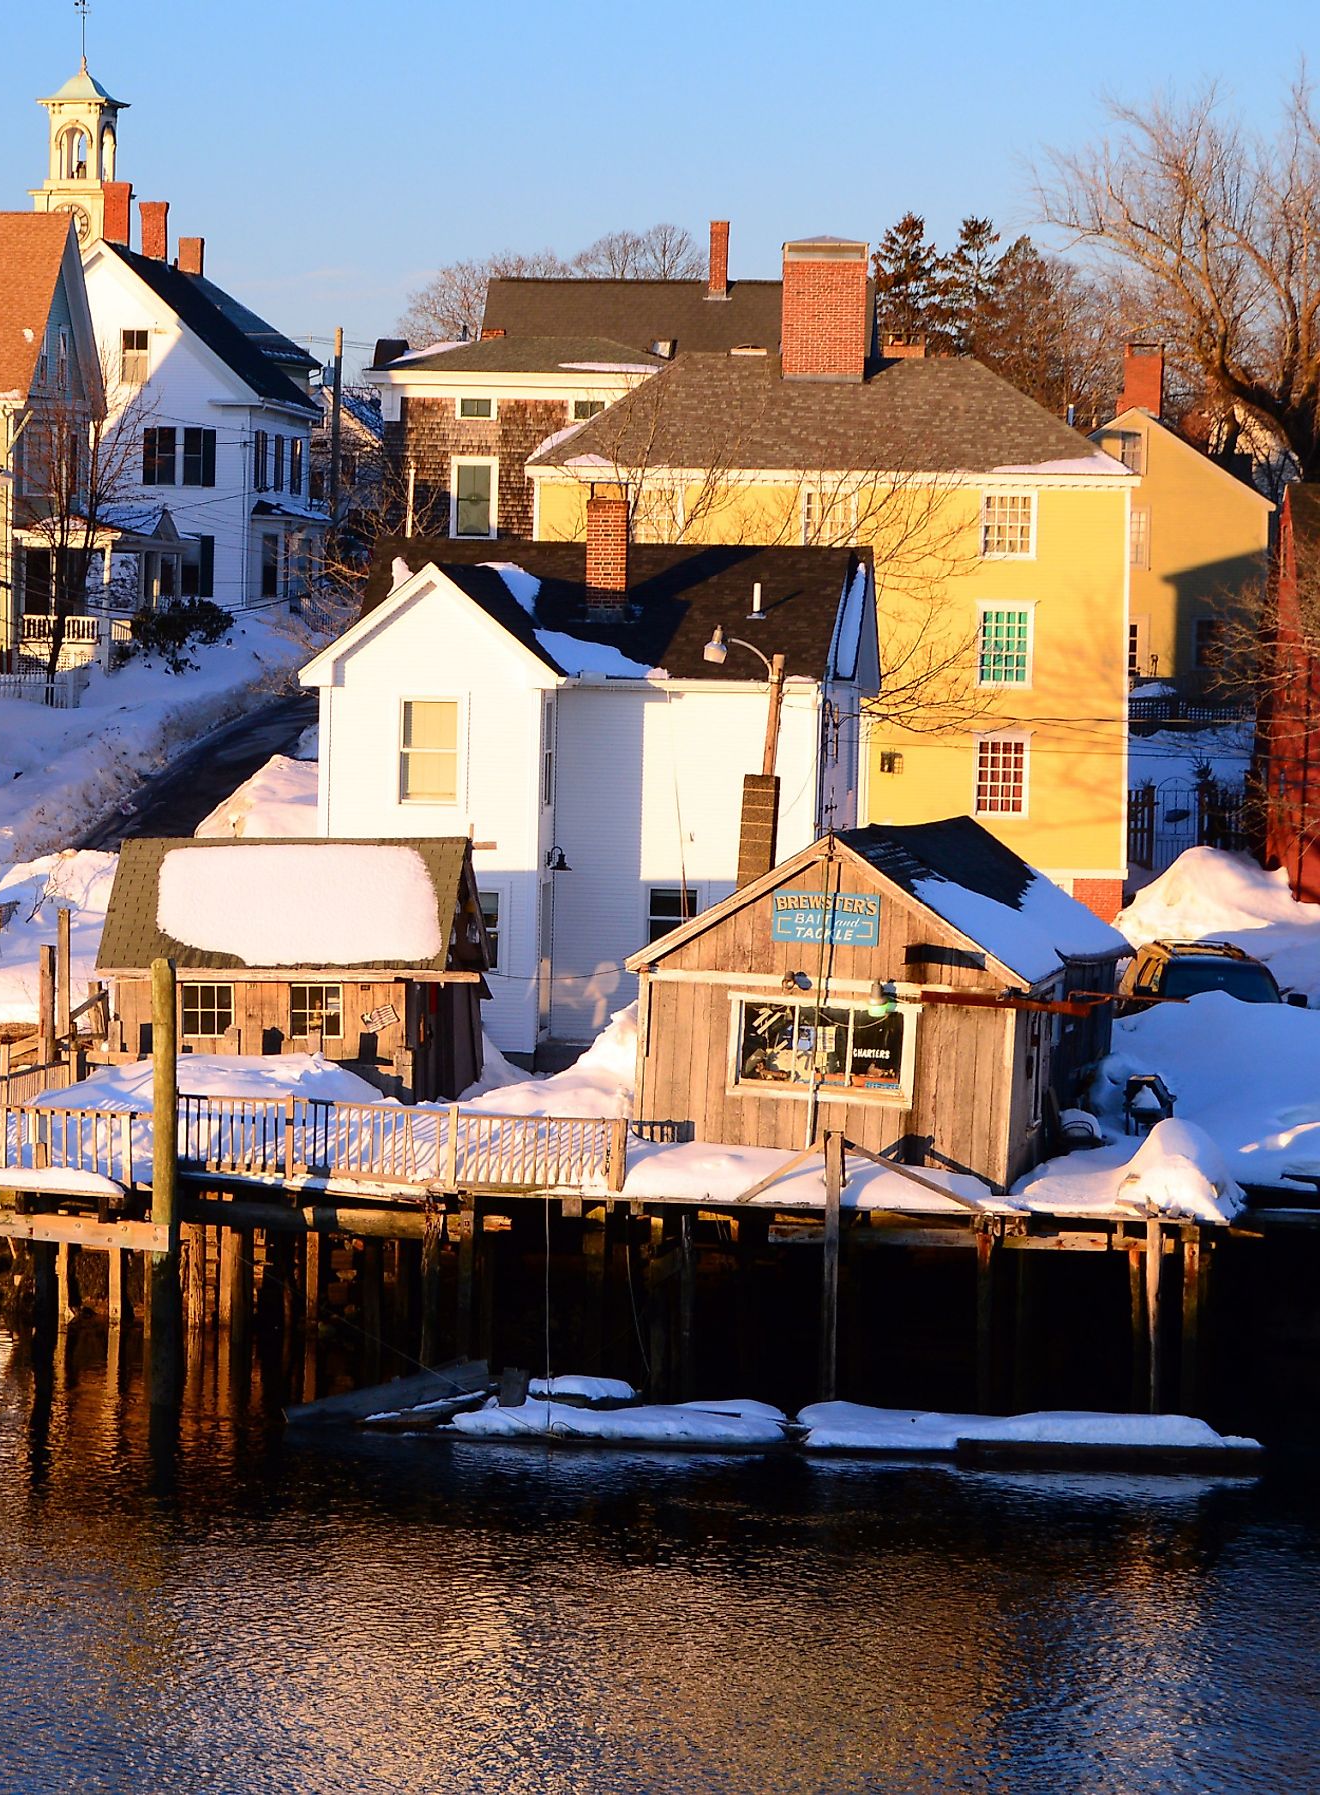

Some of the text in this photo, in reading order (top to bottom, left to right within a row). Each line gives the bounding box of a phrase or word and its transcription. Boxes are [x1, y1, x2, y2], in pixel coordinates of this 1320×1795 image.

[775, 895, 878, 916] BREWSTER'S
[794, 913, 861, 928] BAIT and
[795, 927, 854, 941] TACKLE
[853, 1047, 891, 1060] CHARTERS
